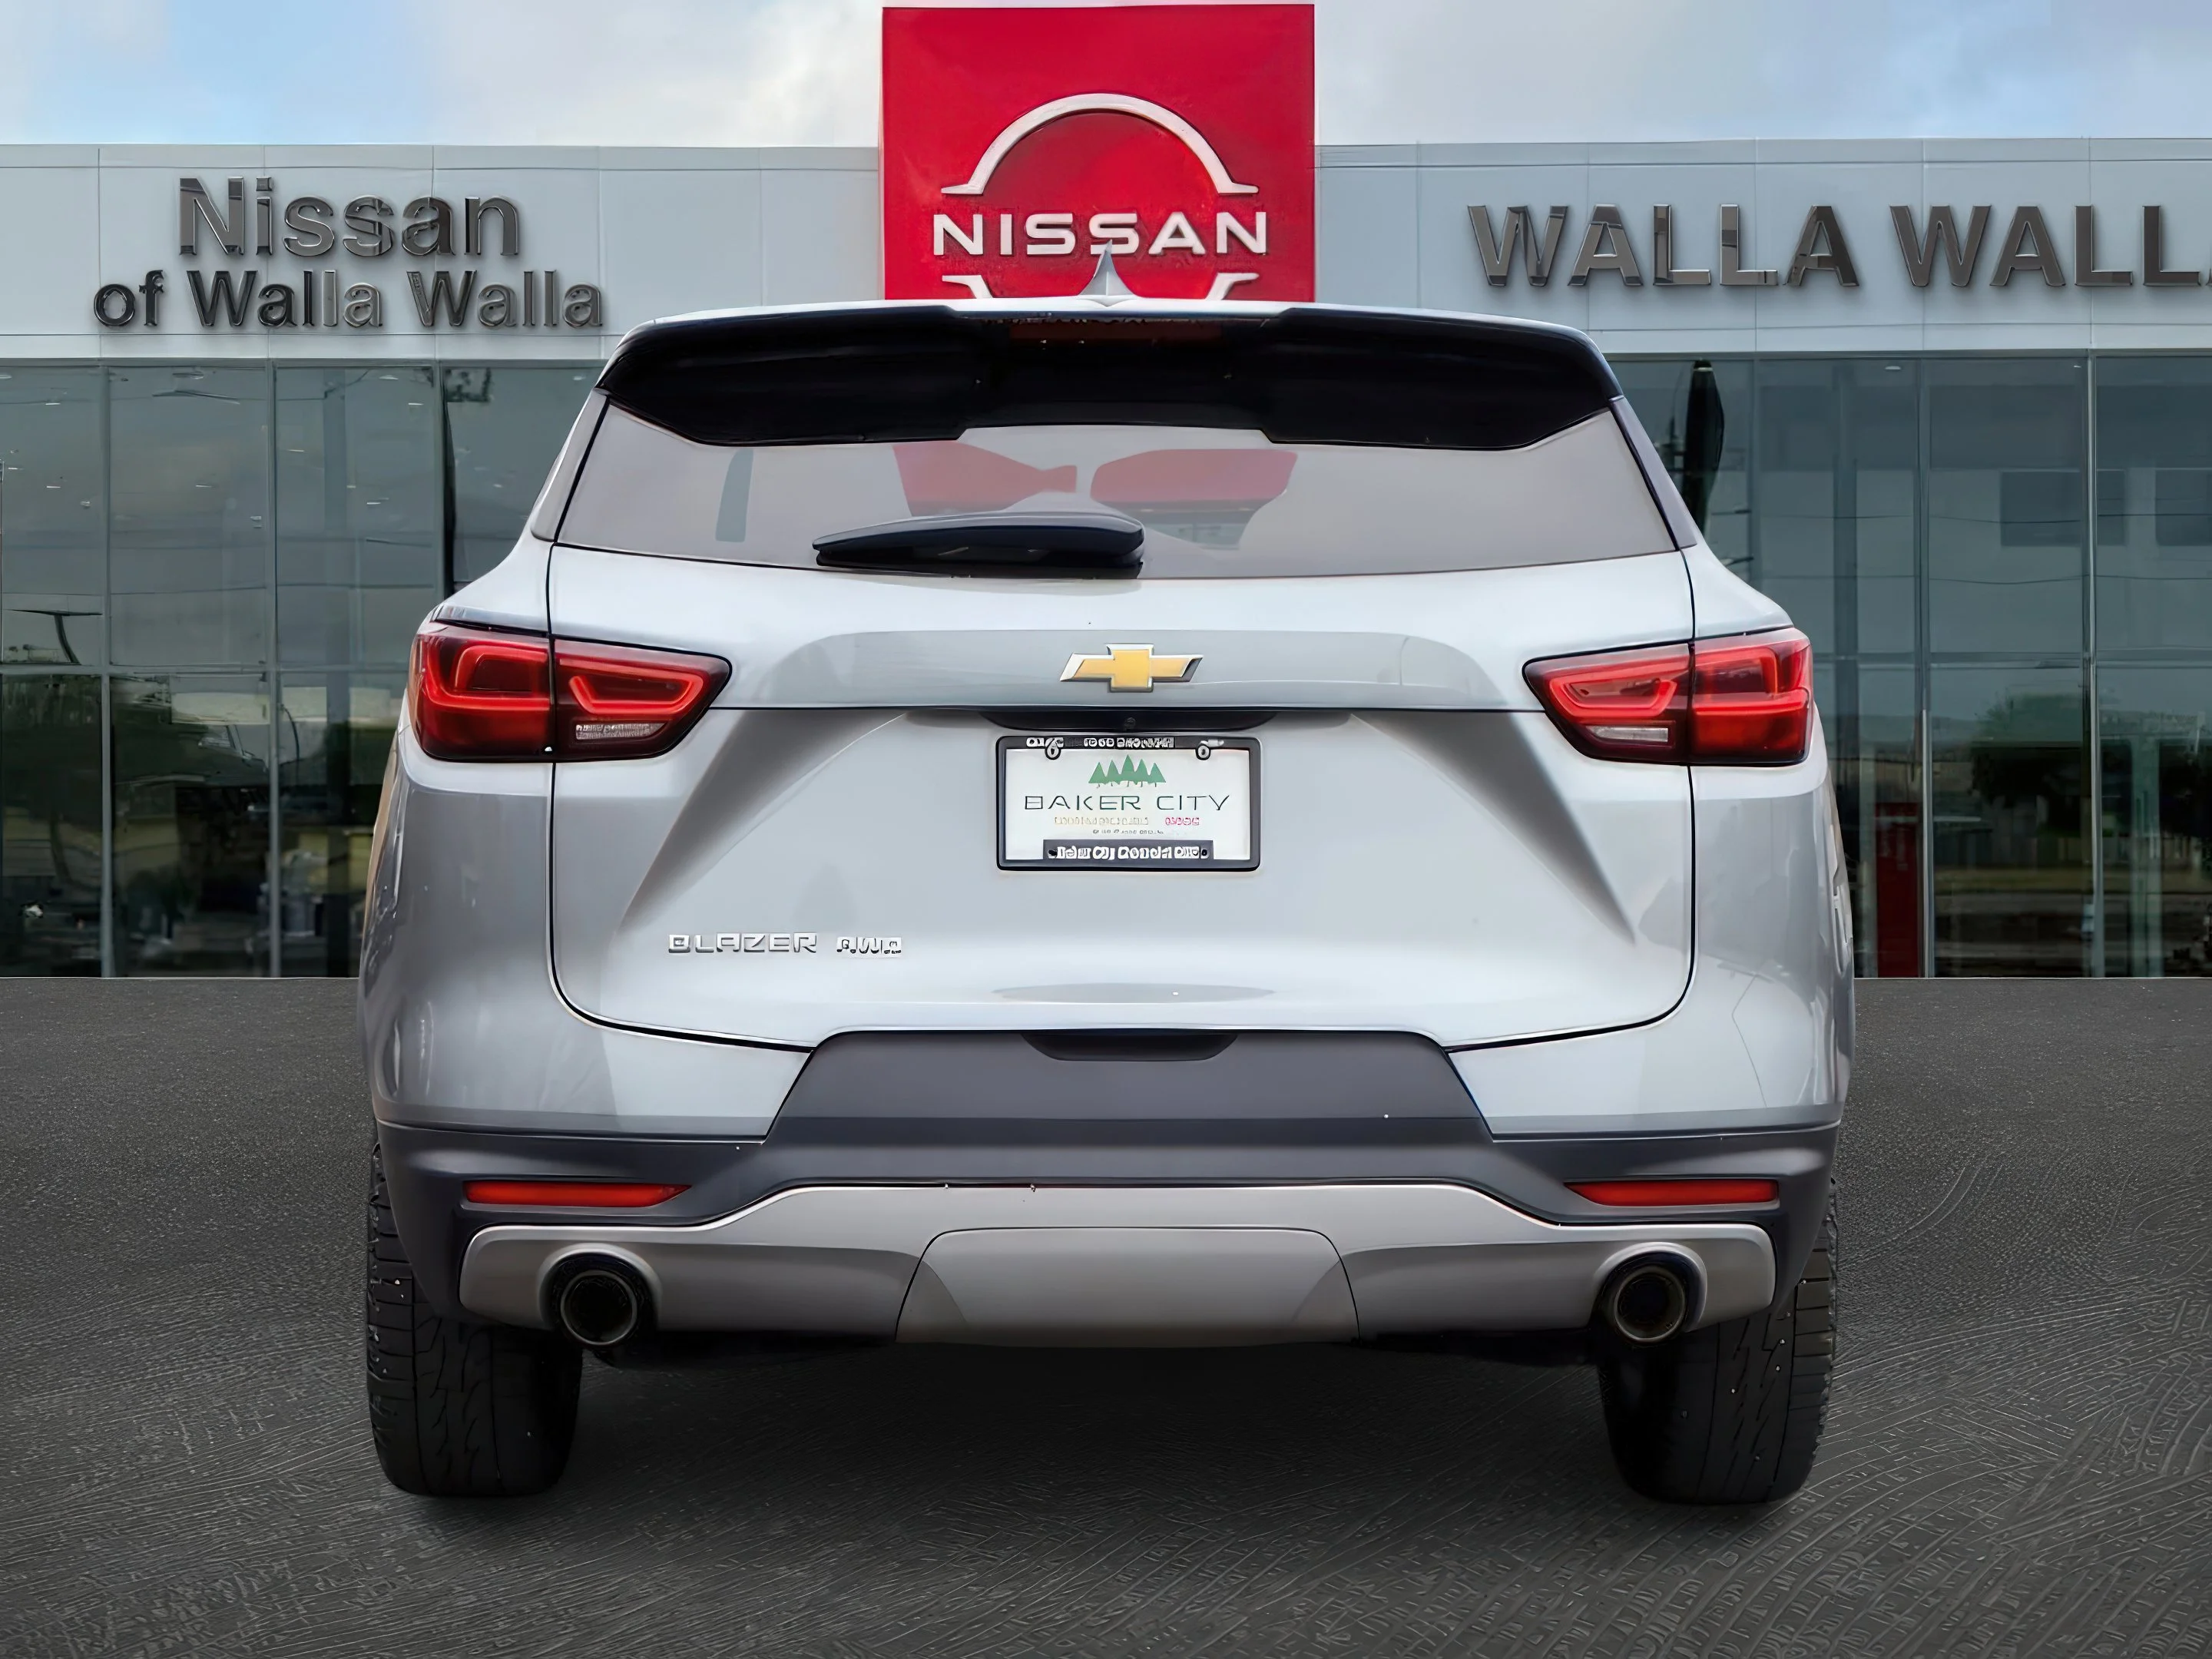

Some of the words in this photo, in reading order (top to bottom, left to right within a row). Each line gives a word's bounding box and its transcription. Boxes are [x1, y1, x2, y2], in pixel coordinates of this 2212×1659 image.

[179, 176, 522, 257] Nissan
[932, 211, 1267, 257] NISSAN
[1467, 204, 1859, 286] WALLA
[1889, 204, 2212, 286] WALL
[94, 269, 164, 327] of
[186, 270, 382, 327] Walla
[406, 270, 603, 327] Walla
[1024, 794, 1141, 811] BAKER
[1157, 794, 1230, 811] CITY
[668, 932, 817, 953] BLAZER
